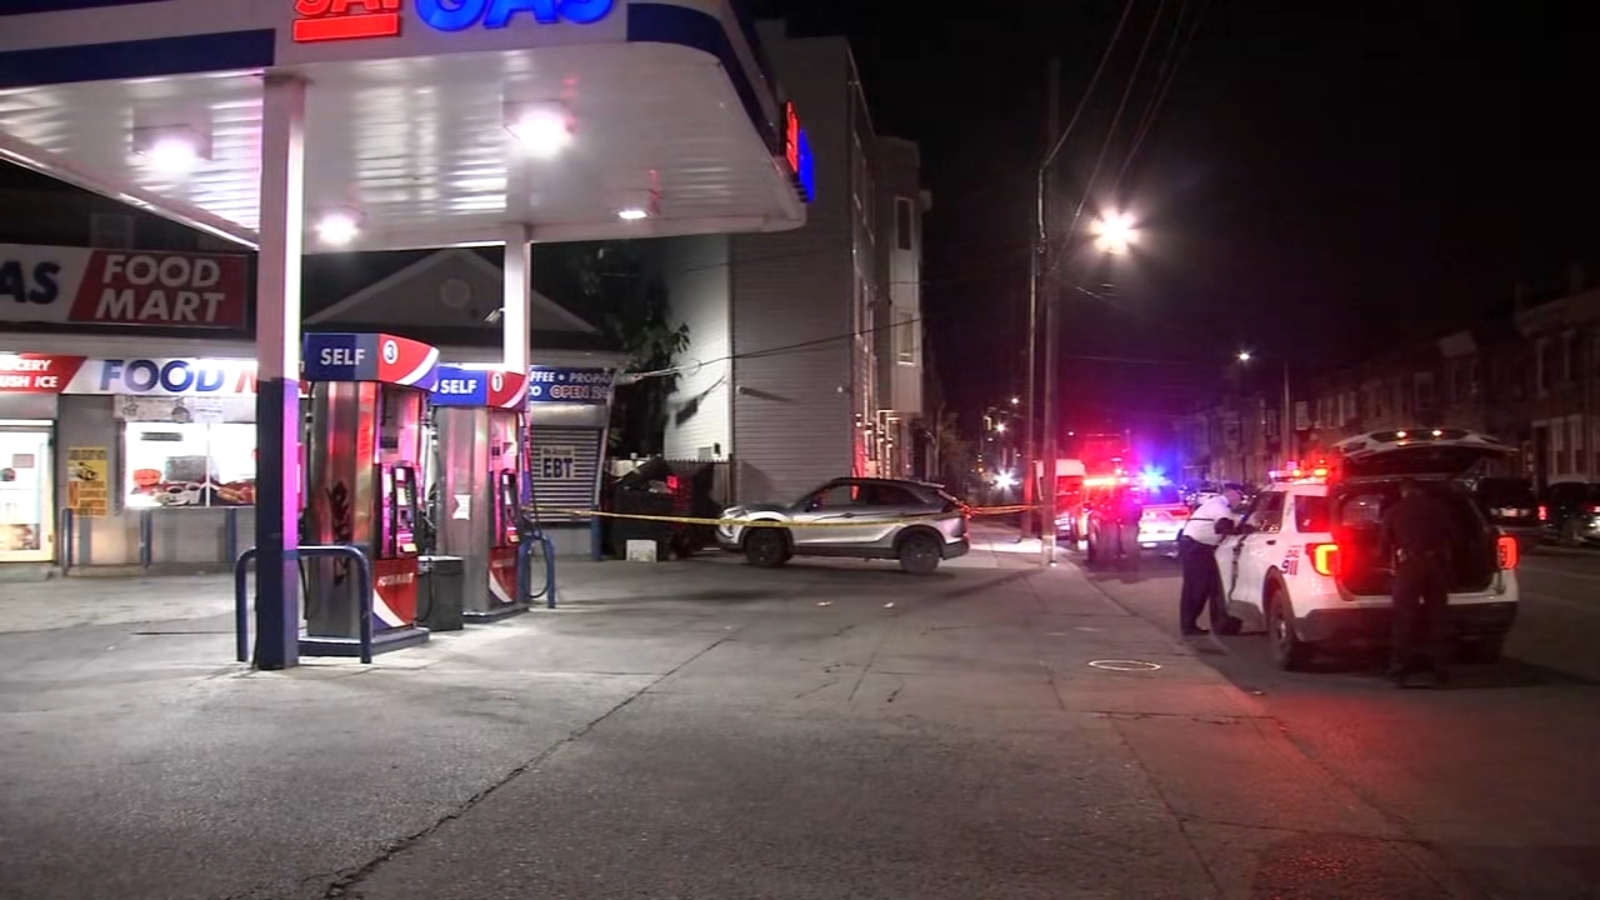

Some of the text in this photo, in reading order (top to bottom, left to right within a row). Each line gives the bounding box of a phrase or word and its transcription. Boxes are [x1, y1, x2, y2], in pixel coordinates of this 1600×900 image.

[103, 255, 220, 287] FOOD
[95, 288, 225, 322] MART
[320, 347, 366, 366] SELF
[387, 344, 395, 361] 3
[34, 375, 59, 388] ICE
[99, 359, 225, 392] FOOD
[440, 379, 478, 394] SELF
[550, 385, 589, 398] OPEN
[544, 458, 572, 478] EBT
